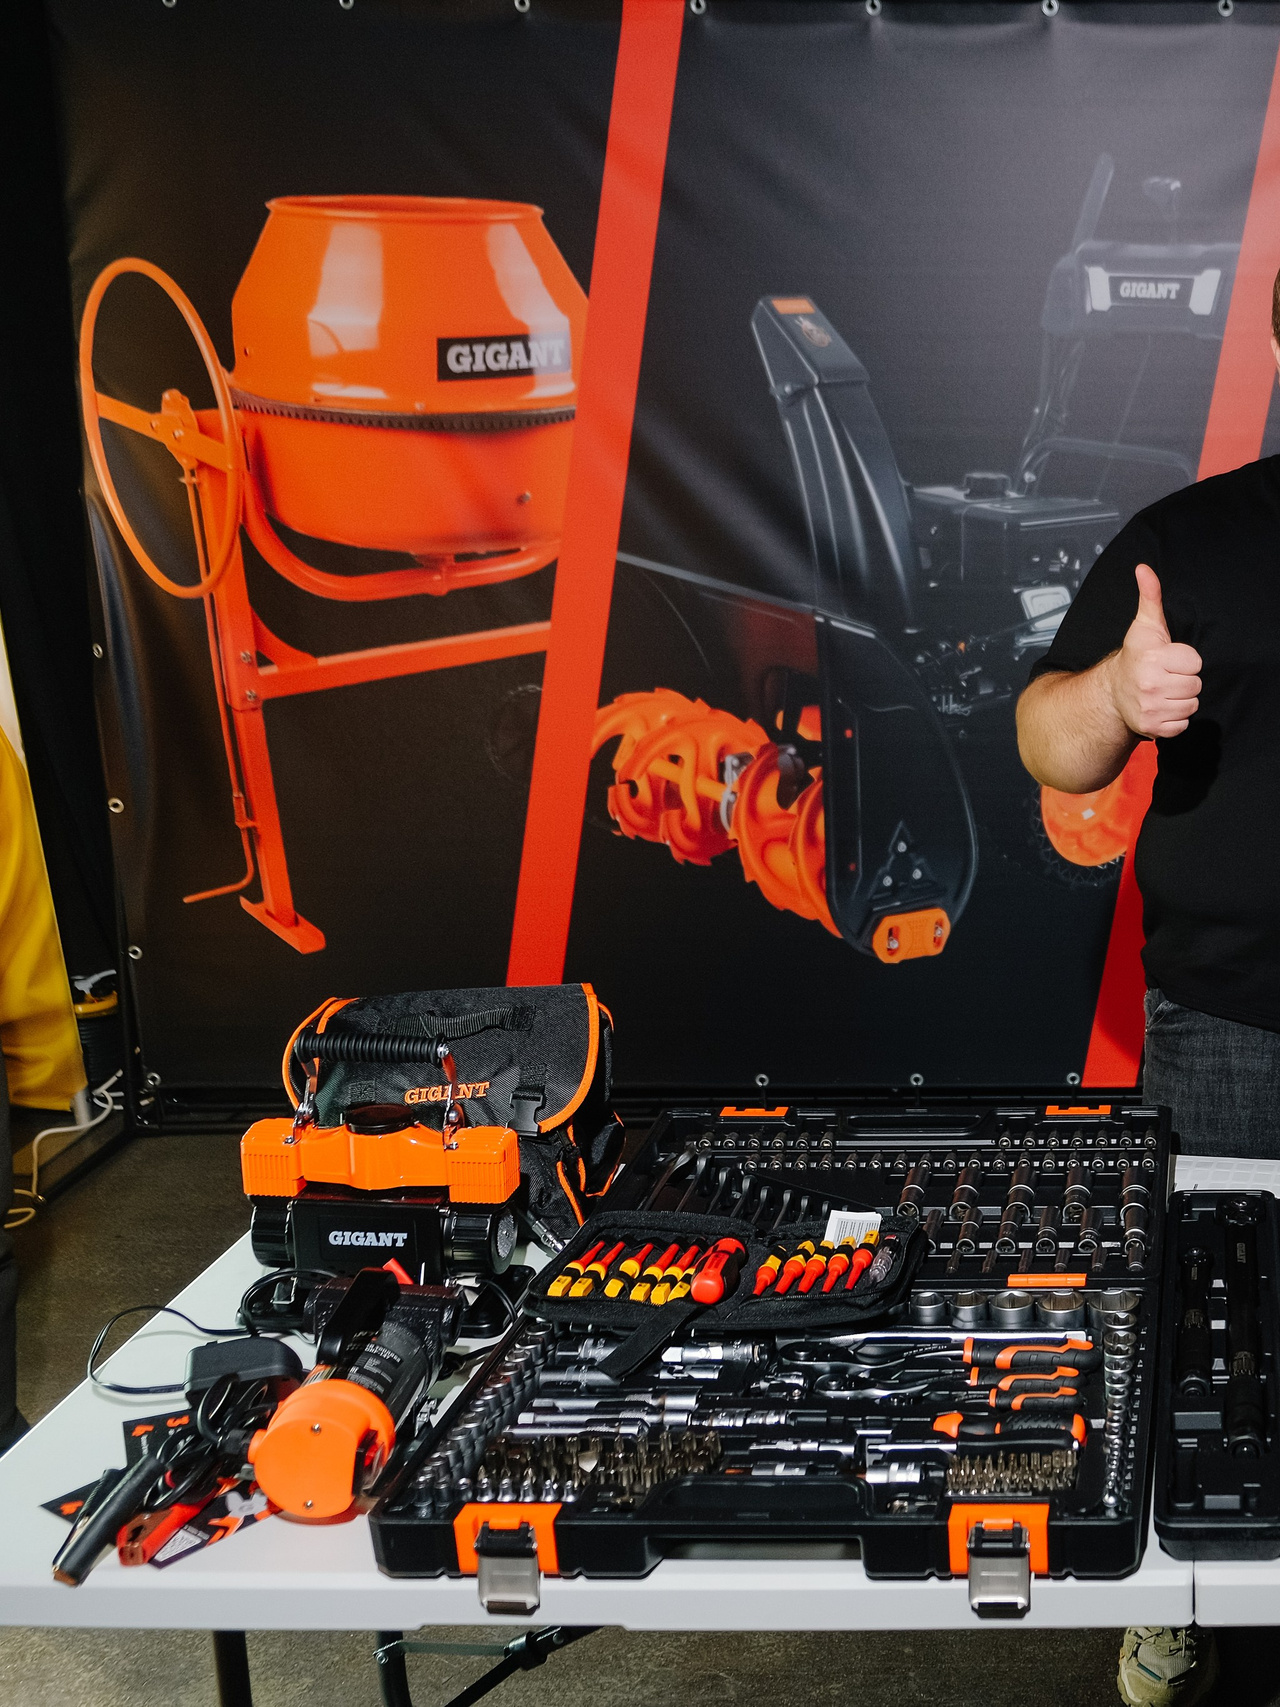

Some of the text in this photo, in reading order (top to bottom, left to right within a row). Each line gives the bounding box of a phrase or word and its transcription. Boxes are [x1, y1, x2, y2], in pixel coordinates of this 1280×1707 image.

[1119, 282, 1180, 299] GIGANT
[446, 339, 565, 374] GIGANT
[328, 1231, 408, 1247] GIGANT
